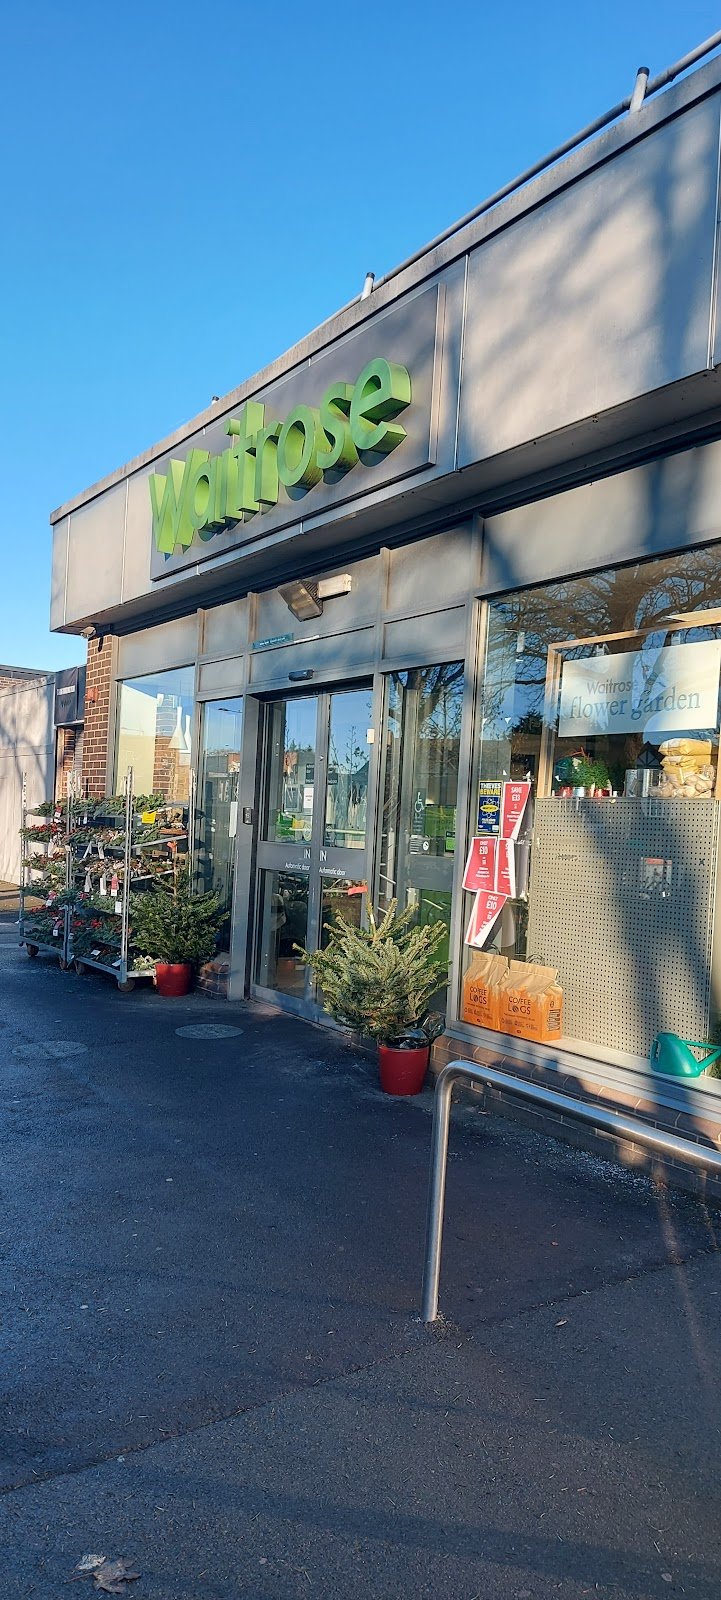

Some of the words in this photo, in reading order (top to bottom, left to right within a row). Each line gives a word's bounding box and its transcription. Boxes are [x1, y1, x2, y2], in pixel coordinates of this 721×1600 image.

[149, 357, 412, 554] Waitrose
[587, 678, 638, 696] Waitrose
[569, 697, 628, 719] flower
[631, 687, 701, 720] garden
[304, 849, 311, 859] IN
[479, 846, 488, 854] £10
[320, 850, 327, 861] IN
[285, 862, 301, 870] Automatic
[319, 867, 336, 875] Automatic
[337, 868, 346, 876] door
[486, 900, 497, 910] £10
[469, 986, 487, 997] COFFEE
[469, 993, 487, 1005] LOGS
[509, 996, 531, 1006] COFFEE
[508, 1005, 531, 1015] LOGS
